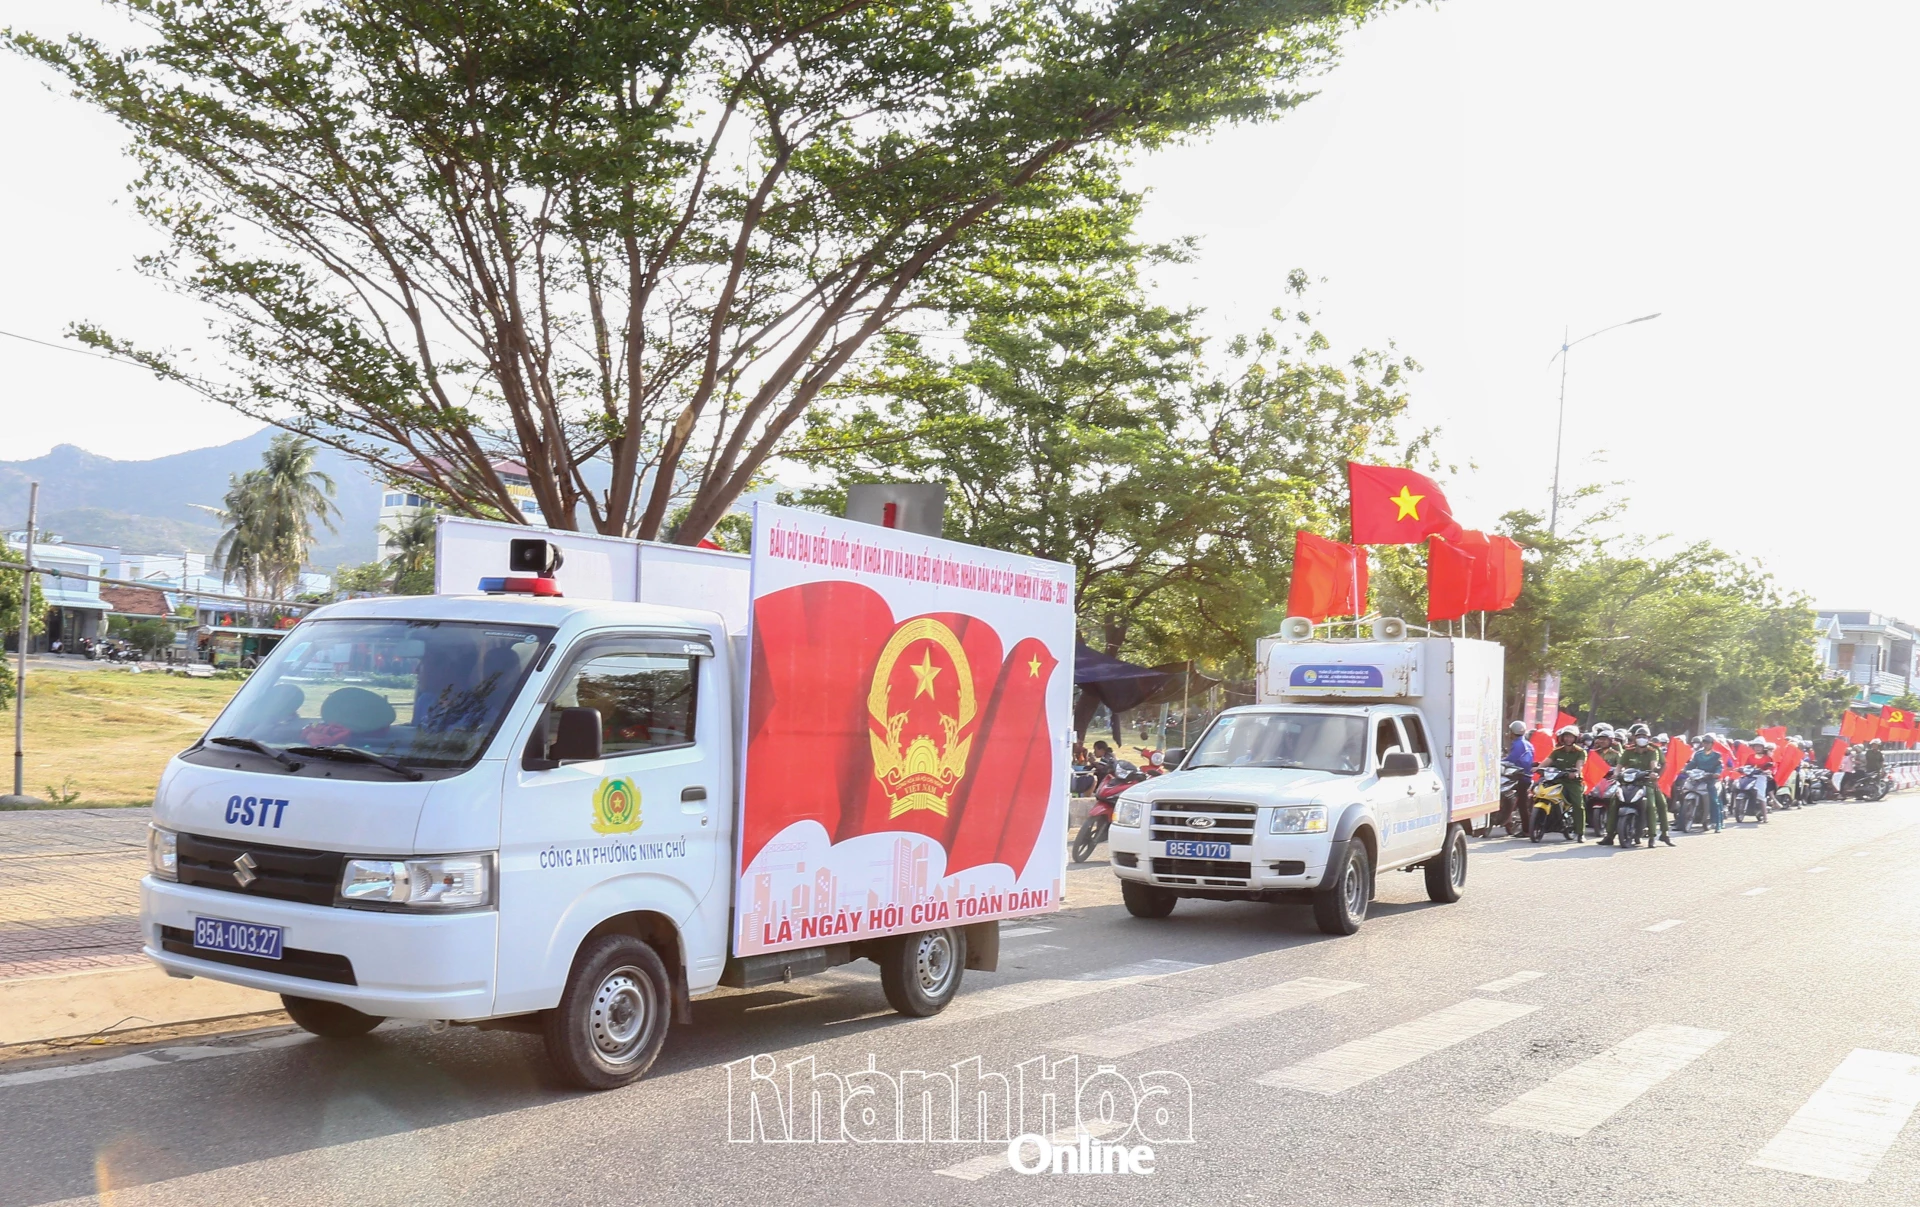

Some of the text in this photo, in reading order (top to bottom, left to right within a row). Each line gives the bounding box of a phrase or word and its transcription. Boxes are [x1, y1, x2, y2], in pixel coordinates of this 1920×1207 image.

[225, 795, 290, 828] CSTT
[540, 845, 573, 868] CÔNG
[576, 848, 590, 866] AN
[593, 840, 637, 864] PHƯỜNG
[639, 842, 664, 861] NINH
[1170, 842, 1227, 857] 85E-0170
[763, 888, 1049, 945] LÀ NGÀY HỘI CỦA TOÀN DÂN!
[197, 920, 279, 955] 85A-003.27
